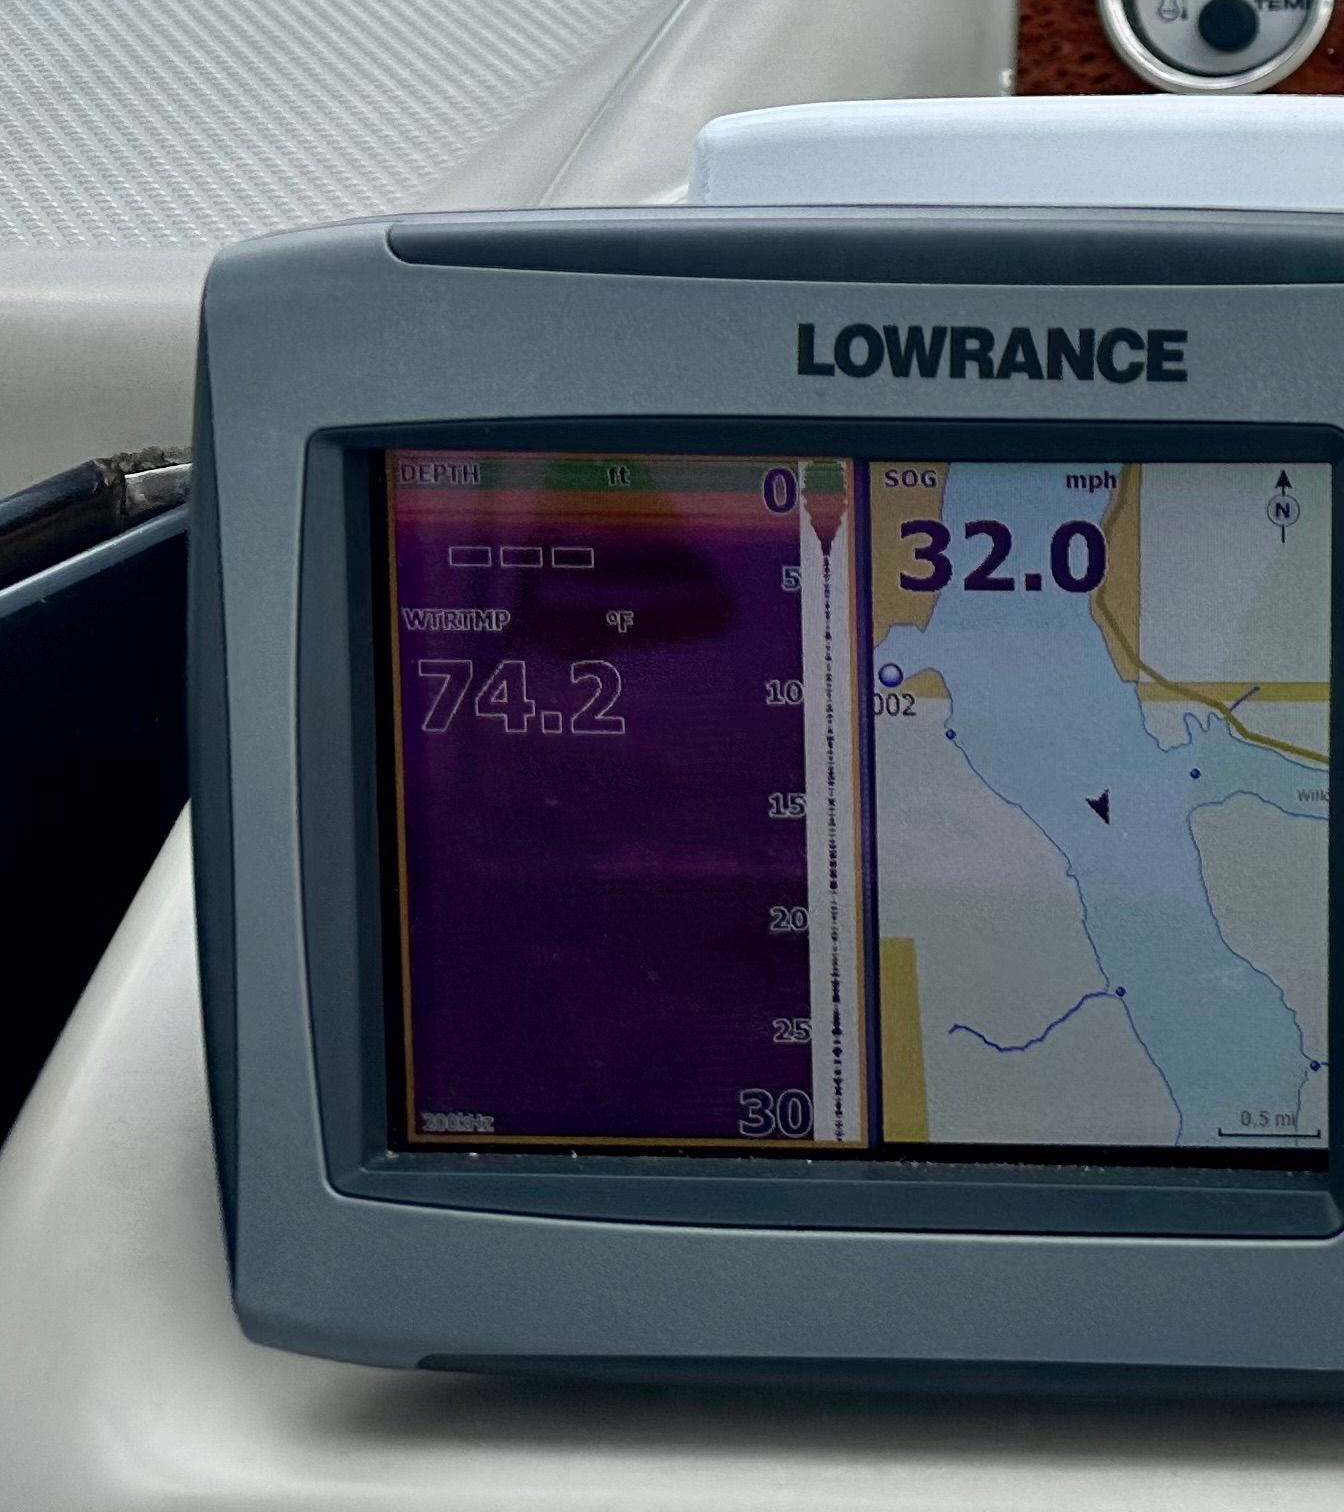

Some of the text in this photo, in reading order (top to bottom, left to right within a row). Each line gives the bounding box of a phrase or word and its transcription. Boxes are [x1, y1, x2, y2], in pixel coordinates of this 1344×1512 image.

[797, 323, 1189, 384] LOWRANCE
[400, 462, 630, 486] DEPTH ft
[884, 469, 1117, 492] SOG mph
[761, 466, 799, 514] 0
[1275, 503, 1291, 518] N
[899, 519, 1108, 593] 32.0
[780, 566, 801, 591] 5
[402, 608, 511, 631] WTRTMP
[418, 659, 626, 734] 74.2
[765, 680, 804, 706] 10
[769, 792, 806, 818] 15
[769, 906, 809, 932] 20
[772, 1018, 812, 1042] 25
[738, 1088, 813, 1137] 30
[1241, 1110, 1270, 1127] 0.5
